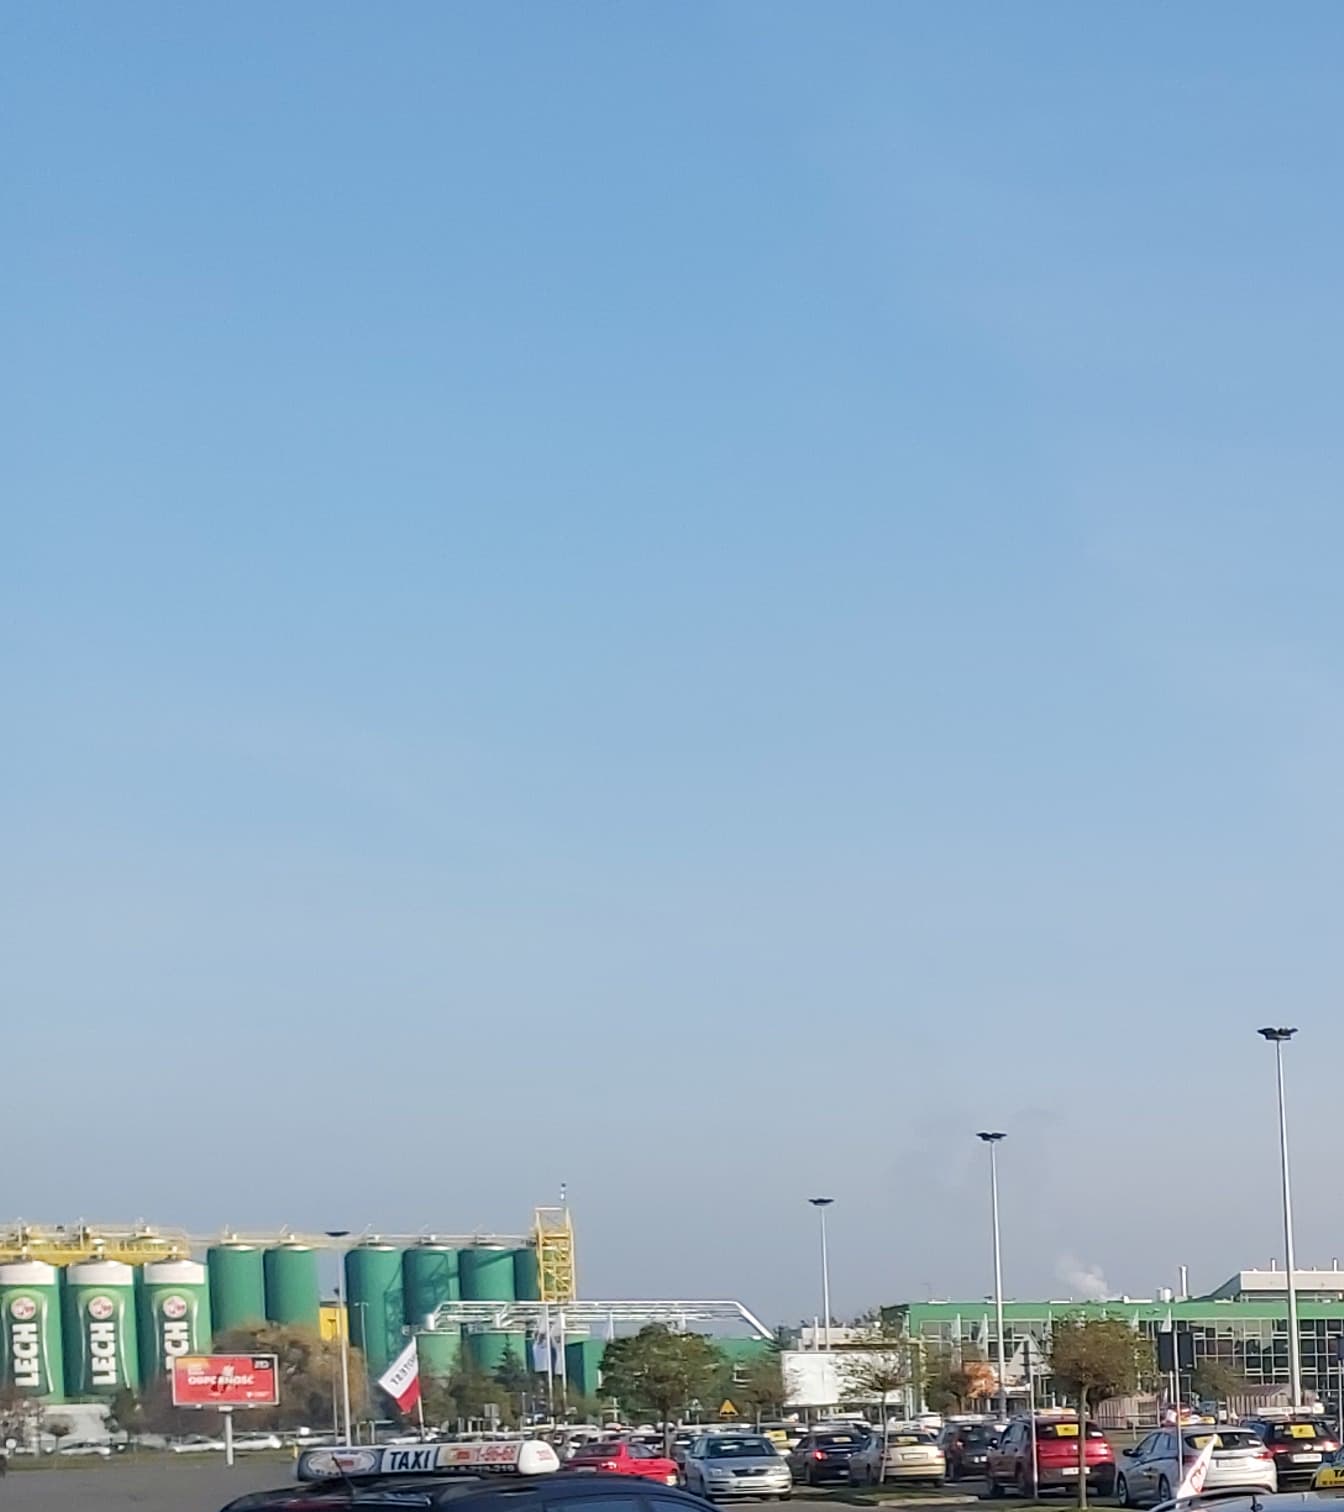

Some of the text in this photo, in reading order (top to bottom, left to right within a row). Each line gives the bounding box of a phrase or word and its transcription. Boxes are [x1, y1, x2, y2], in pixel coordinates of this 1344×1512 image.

[11, 1323, 40, 1387] LECH
[89, 1322, 117, 1385] LECH
[390, 1450, 431, 1471] TAXI
